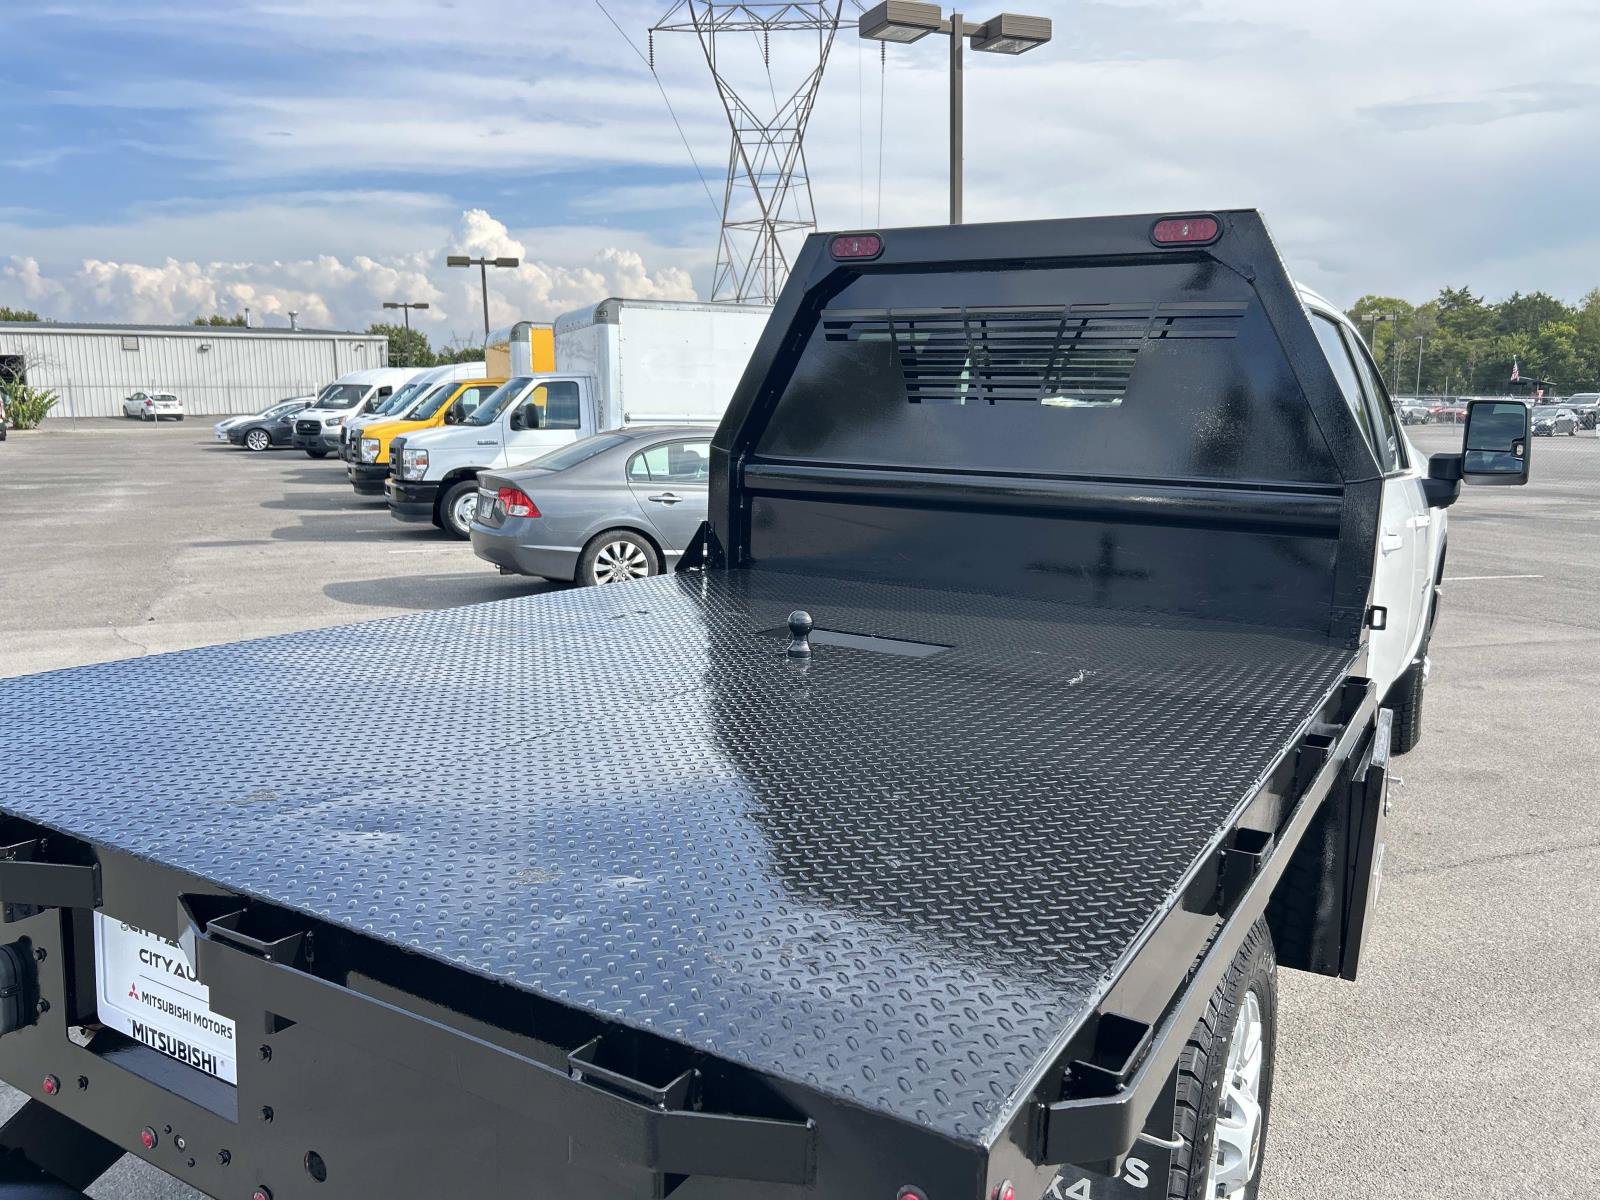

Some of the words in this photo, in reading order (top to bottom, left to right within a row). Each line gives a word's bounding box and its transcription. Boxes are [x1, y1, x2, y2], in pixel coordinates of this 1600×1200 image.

[142, 991, 191, 1023] MITSUBISHI
[194, 1013, 233, 1039] MOTORS
[132, 1020, 217, 1075] MITSUBISHI
